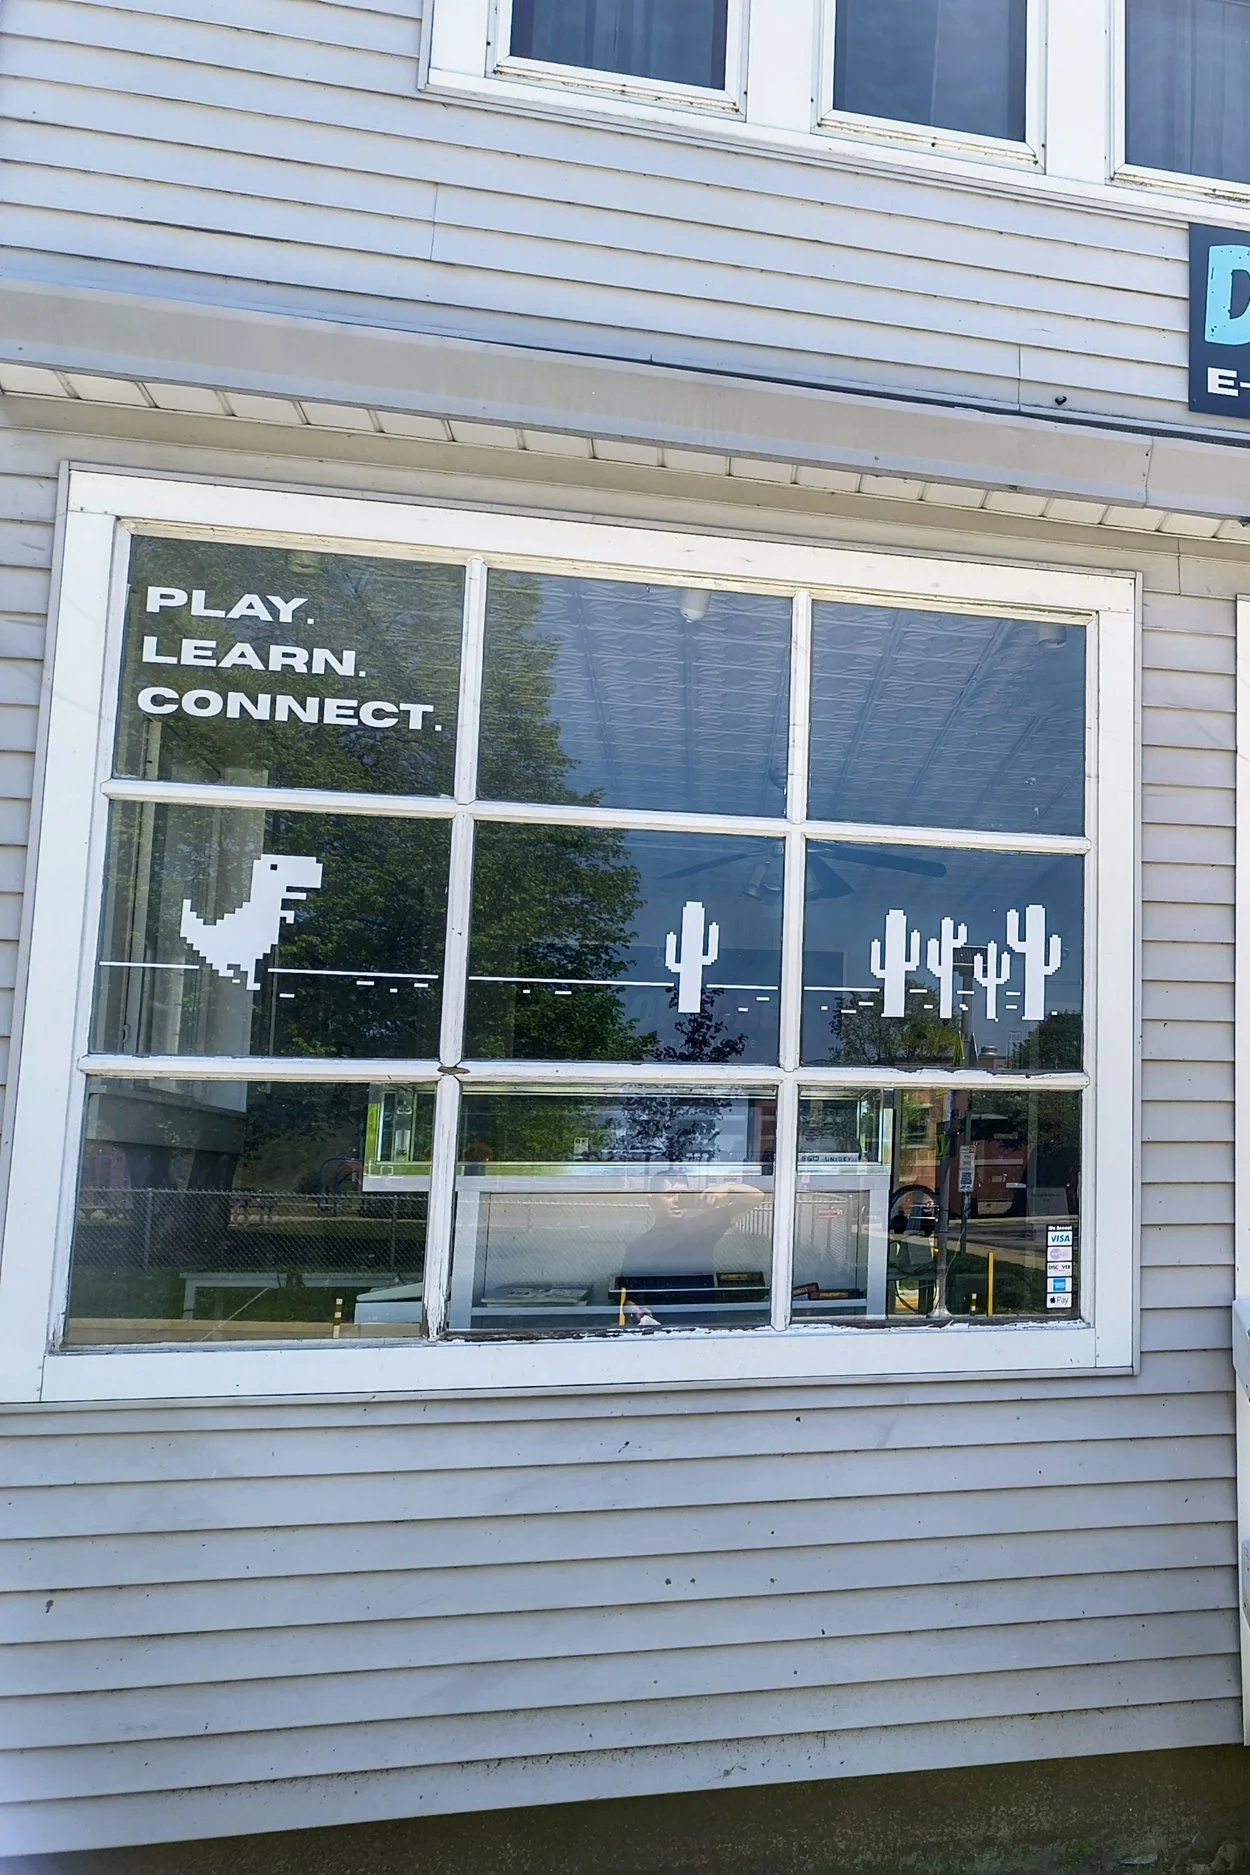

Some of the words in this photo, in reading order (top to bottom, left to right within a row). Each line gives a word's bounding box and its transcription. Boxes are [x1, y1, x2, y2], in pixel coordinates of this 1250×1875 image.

[145, 586, 315, 625] PLAY.
[142, 636, 367, 678] LEARN.
[137, 686, 442, 732] CONNECT.
[1050, 1234, 1071, 1243] VISA
[1056, 1296, 1069, 1306] Pay
